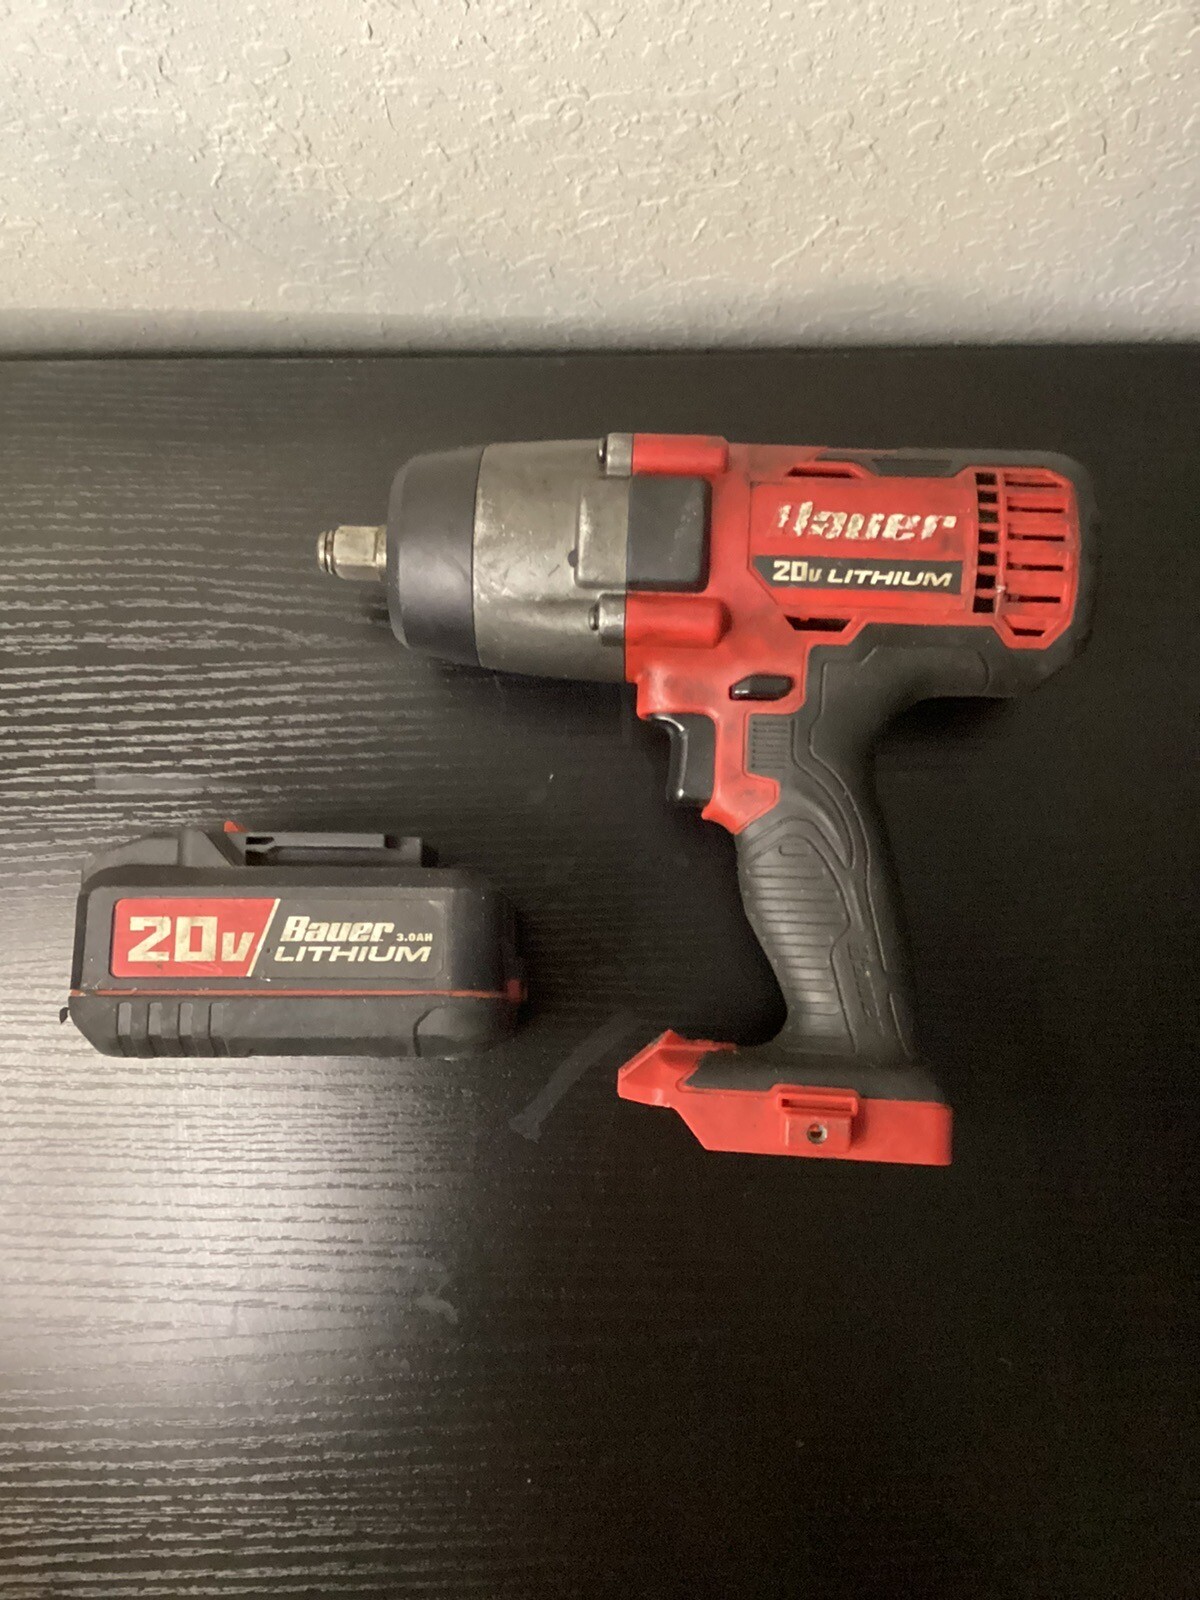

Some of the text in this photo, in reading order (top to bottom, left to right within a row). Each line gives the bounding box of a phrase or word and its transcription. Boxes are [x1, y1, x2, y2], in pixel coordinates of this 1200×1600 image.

[827, 569, 953, 587] LITHIUM
[280, 916, 433, 943] Bauer 3.0AH
[274, 946, 432, 962] LITHIUM
